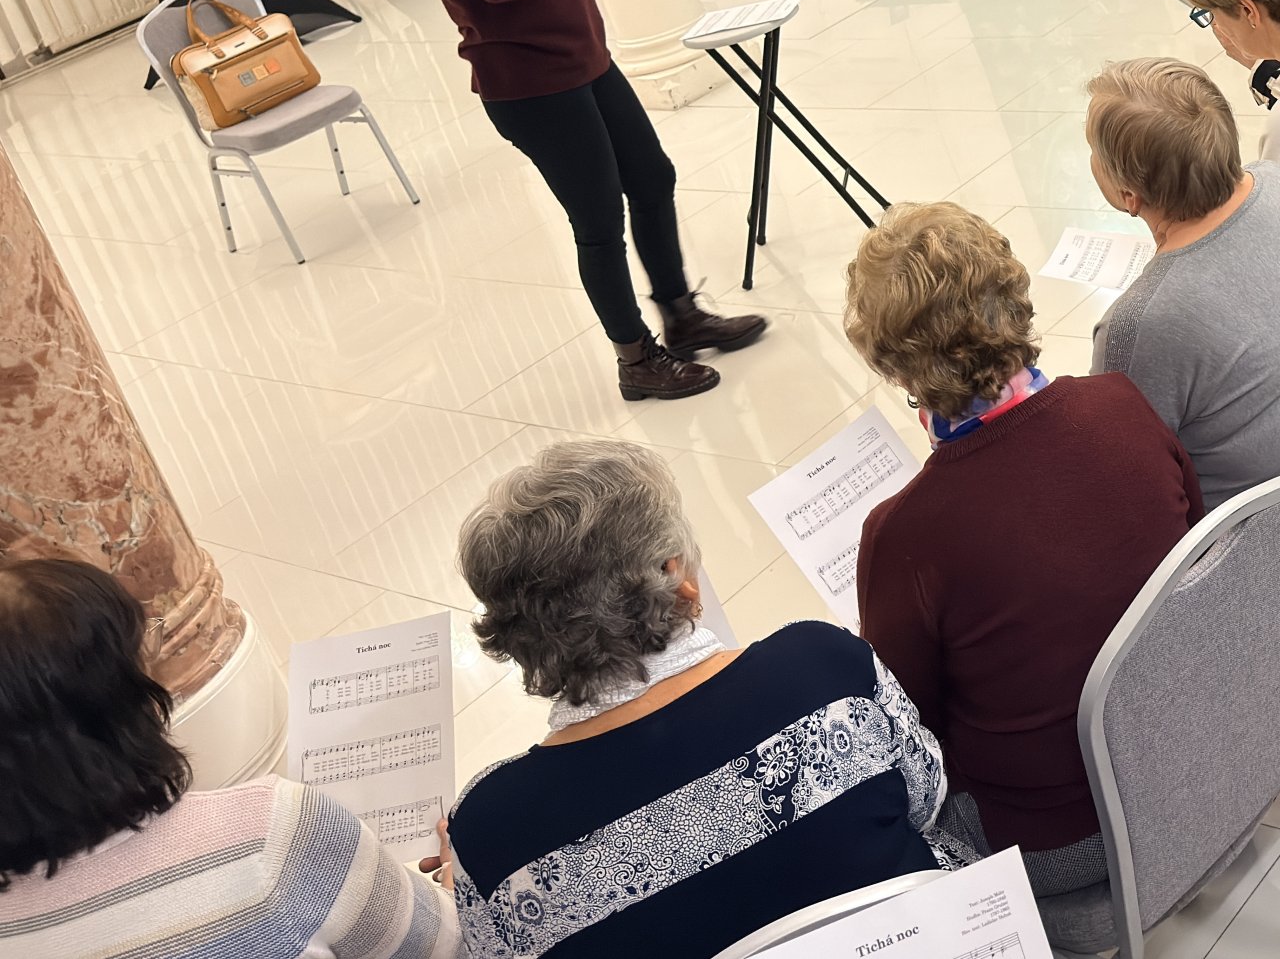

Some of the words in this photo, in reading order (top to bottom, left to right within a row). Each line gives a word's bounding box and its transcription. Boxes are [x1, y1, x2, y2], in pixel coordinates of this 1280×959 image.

[807, 464, 825, 479] Tichá
[825, 456, 836, 466] noc
[356, 644, 377, 653] Tichá
[855, 934, 894, 958] Tichá
[896, 926, 920, 942] noc
